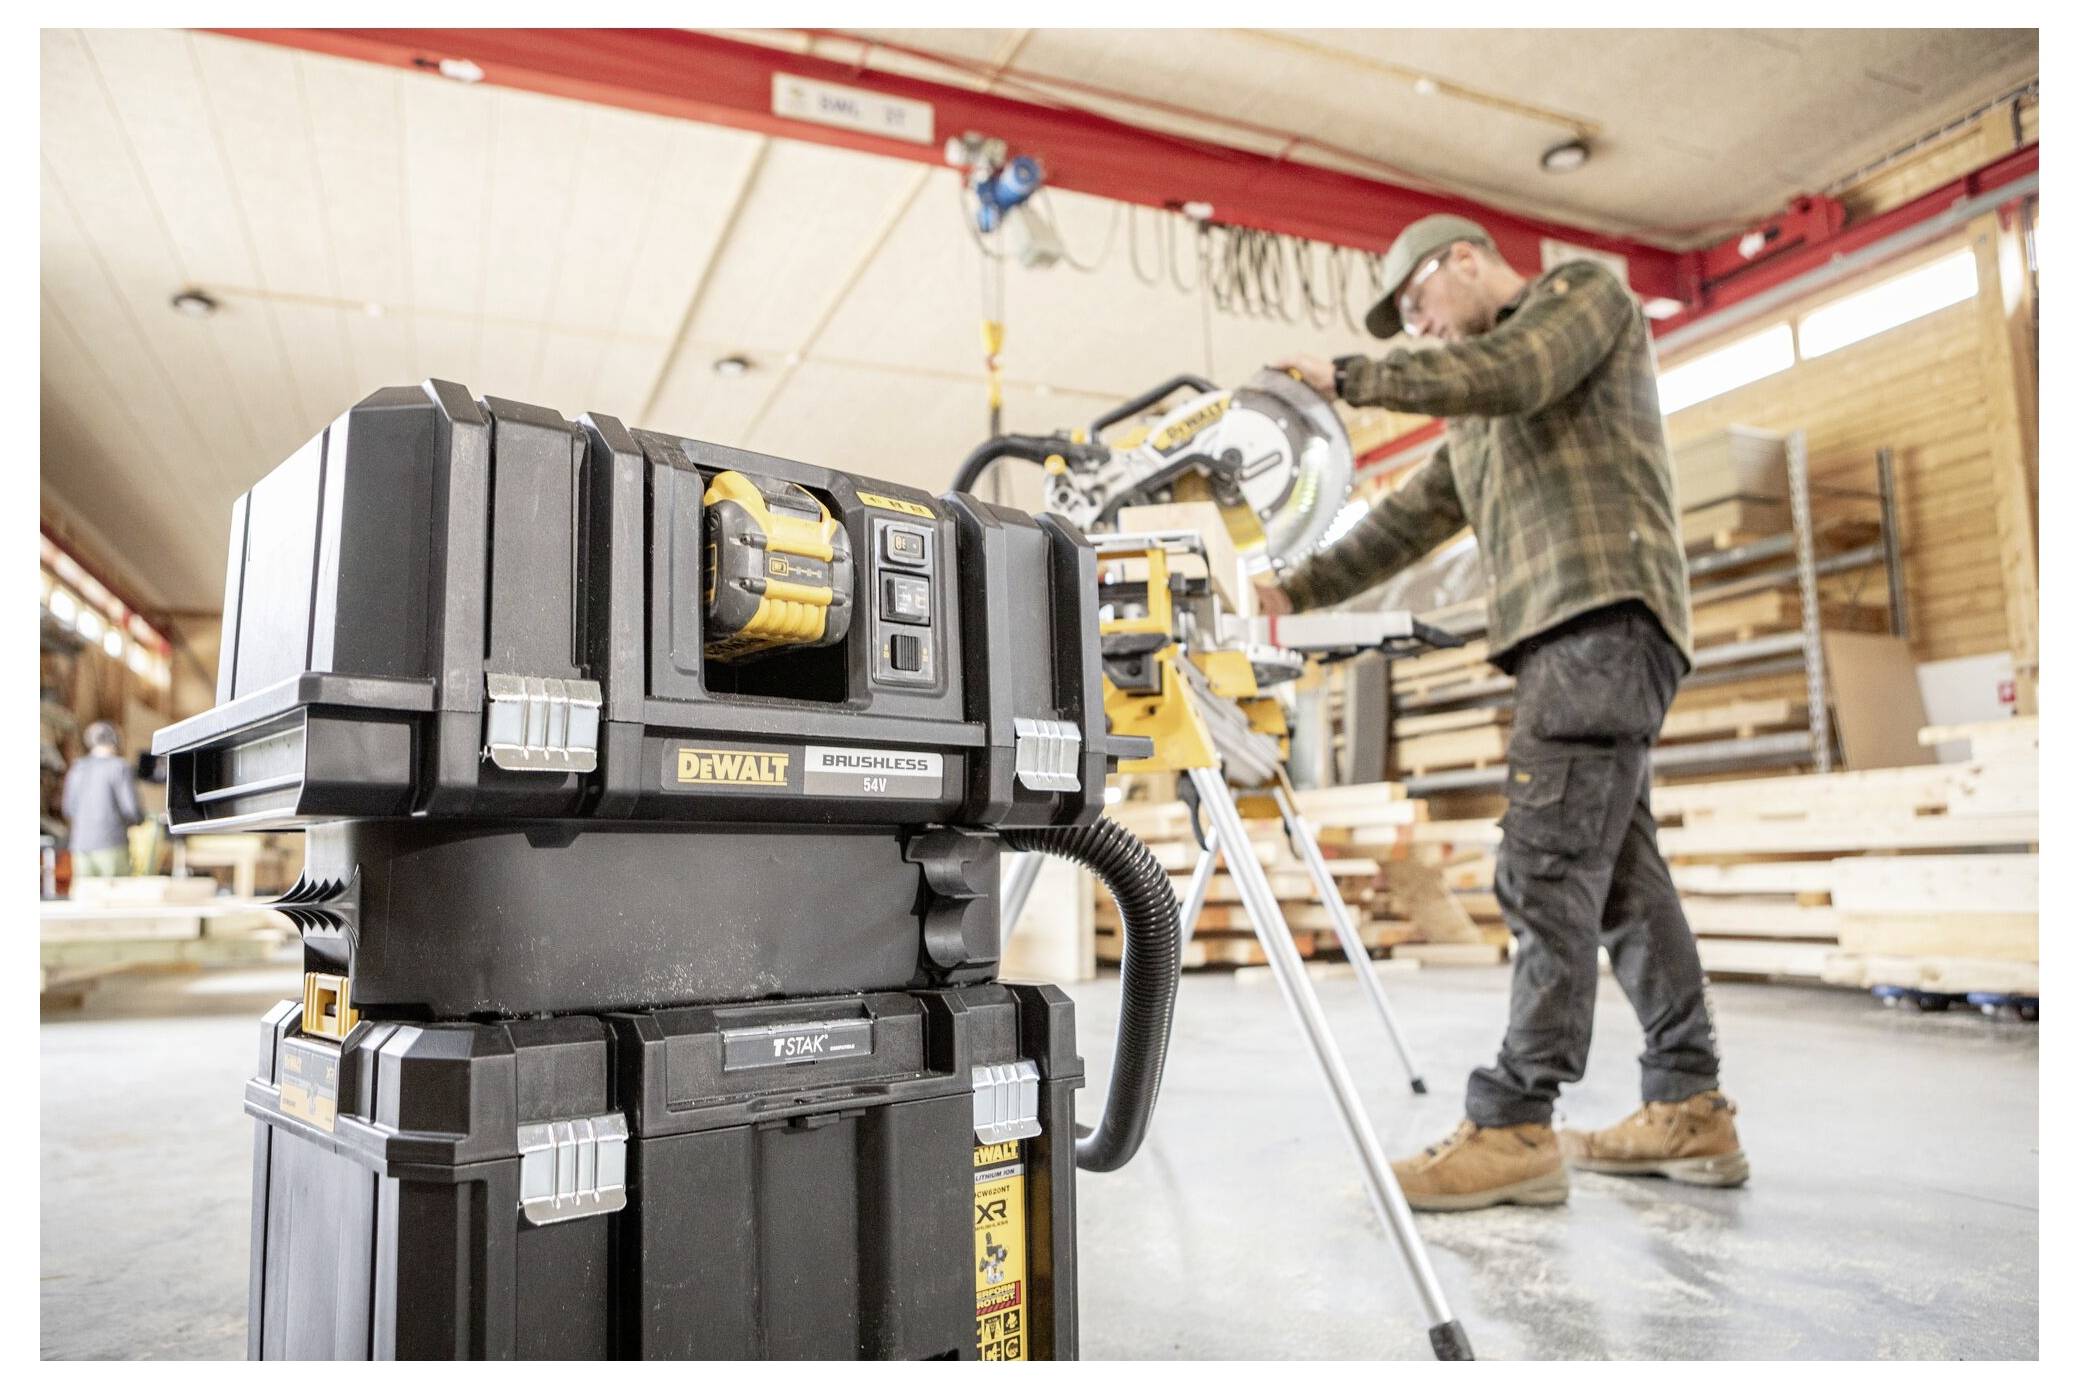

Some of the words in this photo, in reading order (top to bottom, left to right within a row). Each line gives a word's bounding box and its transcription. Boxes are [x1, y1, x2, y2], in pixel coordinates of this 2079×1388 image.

[822, 754, 928, 771] BRUSHLESS
[863, 777, 887, 793] 54V
[975, 1171, 1002, 1182] LITHIUM
[1003, 1168, 1015, 1177] ION
[975, 1185, 1011, 1199] CW620NT
[976, 1199, 1007, 1224] XR
